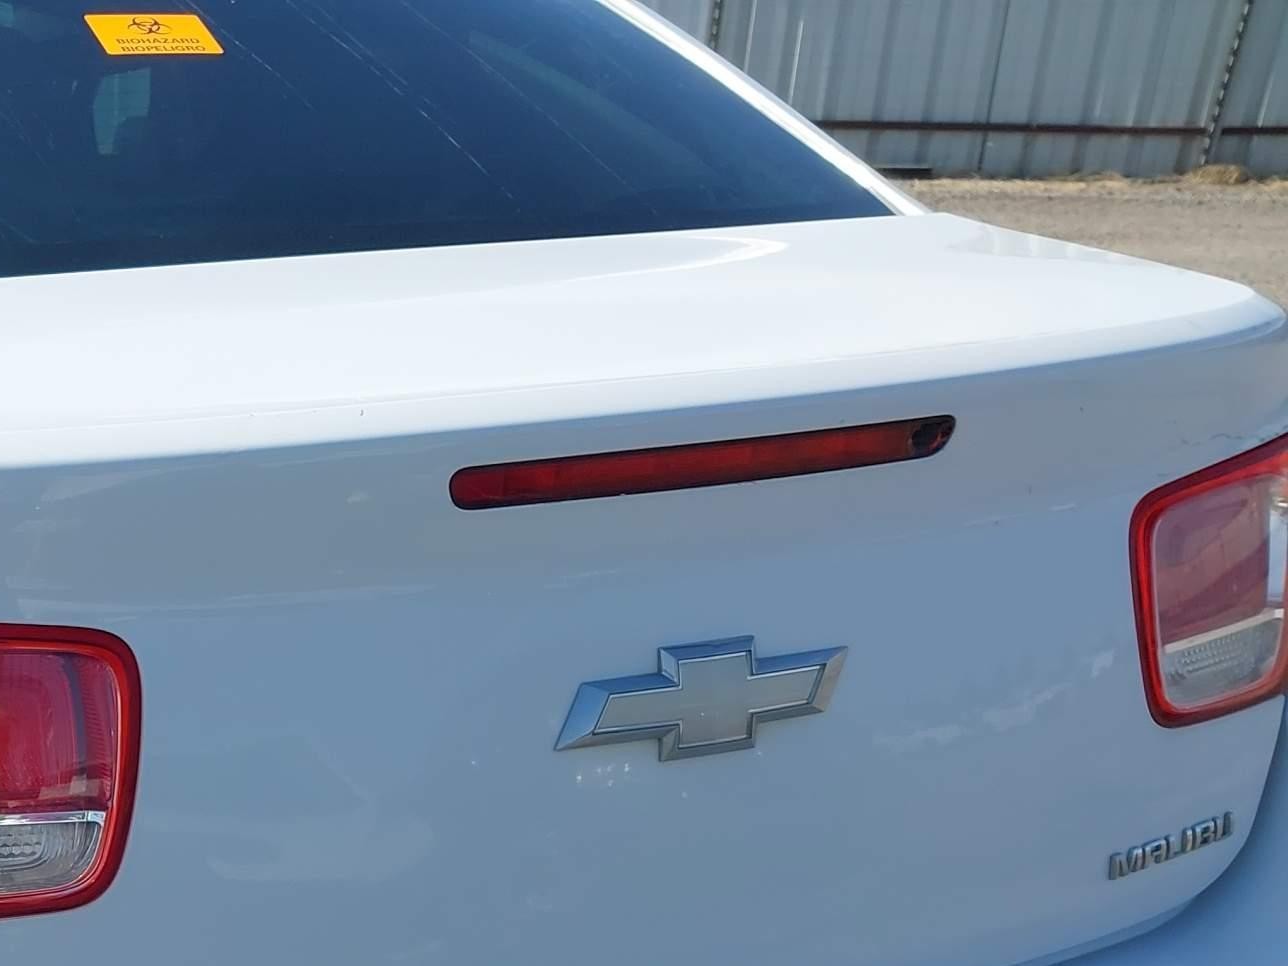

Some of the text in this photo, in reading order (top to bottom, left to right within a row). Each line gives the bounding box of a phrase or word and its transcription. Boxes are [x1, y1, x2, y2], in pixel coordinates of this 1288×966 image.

[116, 37, 201, 45] BIOHAZARD
[120, 45, 206, 53] BIOPELIGRO
[1108, 811, 1234, 880] MALIBU
